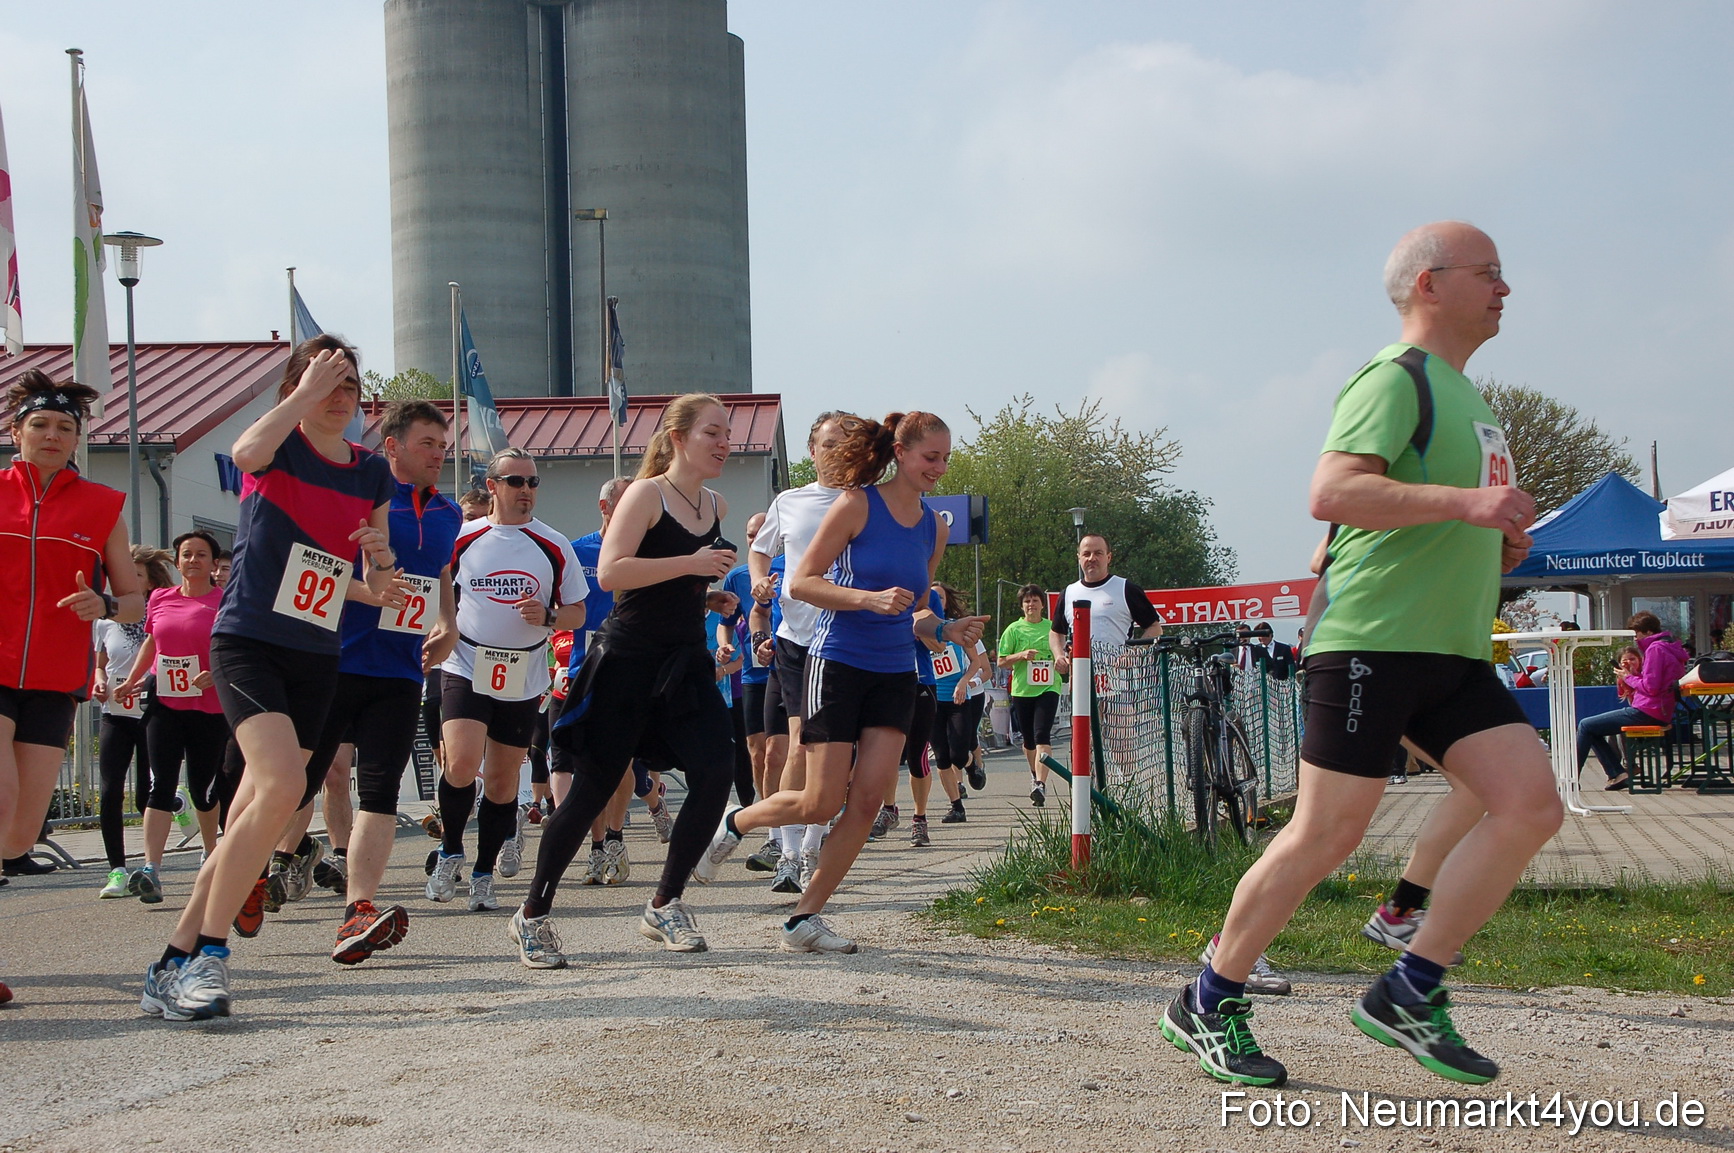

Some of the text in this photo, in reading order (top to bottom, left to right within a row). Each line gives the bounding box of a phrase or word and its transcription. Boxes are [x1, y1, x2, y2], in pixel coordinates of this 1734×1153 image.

[302, 557, 332, 573] WERBUNG
[303, 550, 333, 567] MEYER
[1546, 551, 1705, 571] Neumarkter Tagblatt
[470, 578, 525, 587] GERHART
[293, 570, 336, 618] 92
[396, 595, 426, 630] 72
[485, 650, 509, 658] MEYER
[933, 656, 953, 675] 60
[1032, 667, 1049, 683] 80
[167, 668, 190, 692] 13
[491, 663, 507, 691] 6
[1346, 683, 1363, 732] odlo
